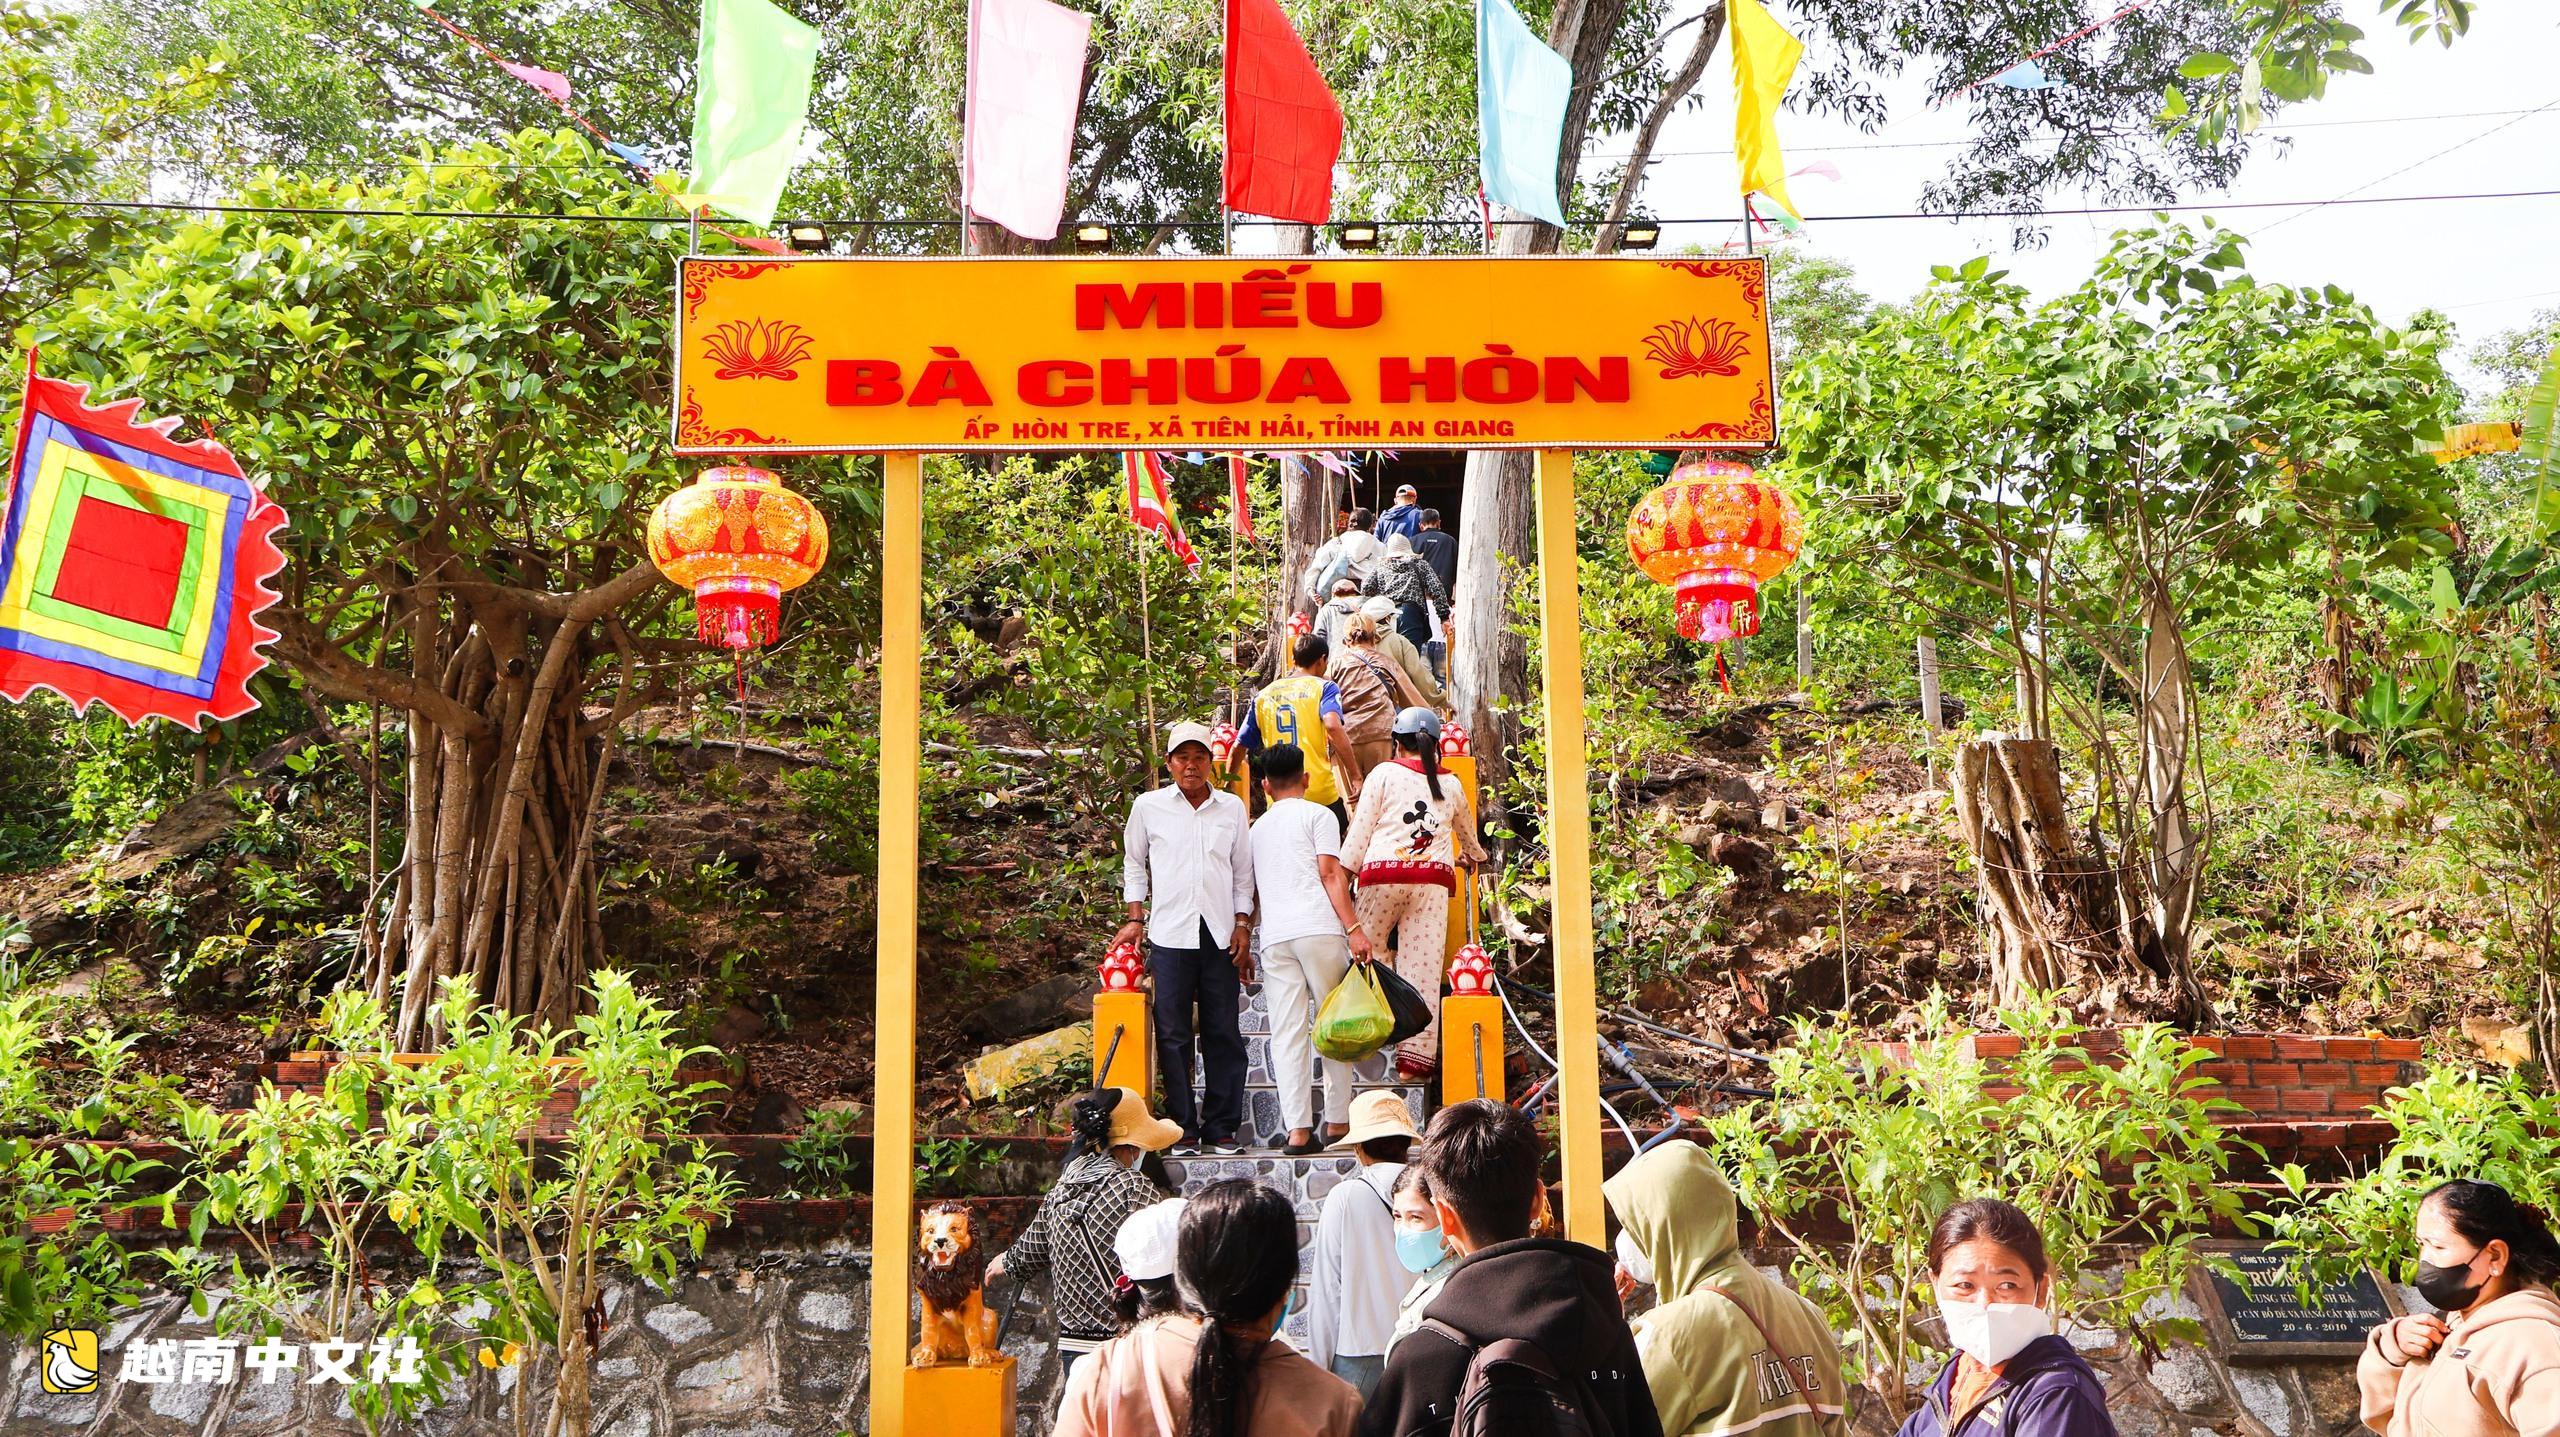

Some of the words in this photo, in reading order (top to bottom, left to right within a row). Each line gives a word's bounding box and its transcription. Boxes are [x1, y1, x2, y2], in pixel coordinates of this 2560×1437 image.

[1075, 264, 1383, 331] MIẾU
[826, 346, 994, 407] BÀ
[1017, 344, 1352, 408] CHÚA
[1379, 343, 1631, 405] HÒN
[963, 415, 1000, 439] ẤP
[1012, 417, 1068, 439] HÒN
[1079, 421, 1142, 442] TRE,
[1148, 415, 1184, 438] XÃ
[1191, 416, 1250, 438] TIÊN
[1260, 413, 1313, 440] HẢI,
[1320, 413, 1380, 437] TỈNH
[1389, 420, 1424, 437] AN
[1433, 419, 1515, 437] GIANG
[1276, 704, 1298, 746] 9
[2282, 1322, 2296, 1332] 20
[2305, 1322, 2313, 1332] 6
[2321, 1322, 2348, 1332] 2010
